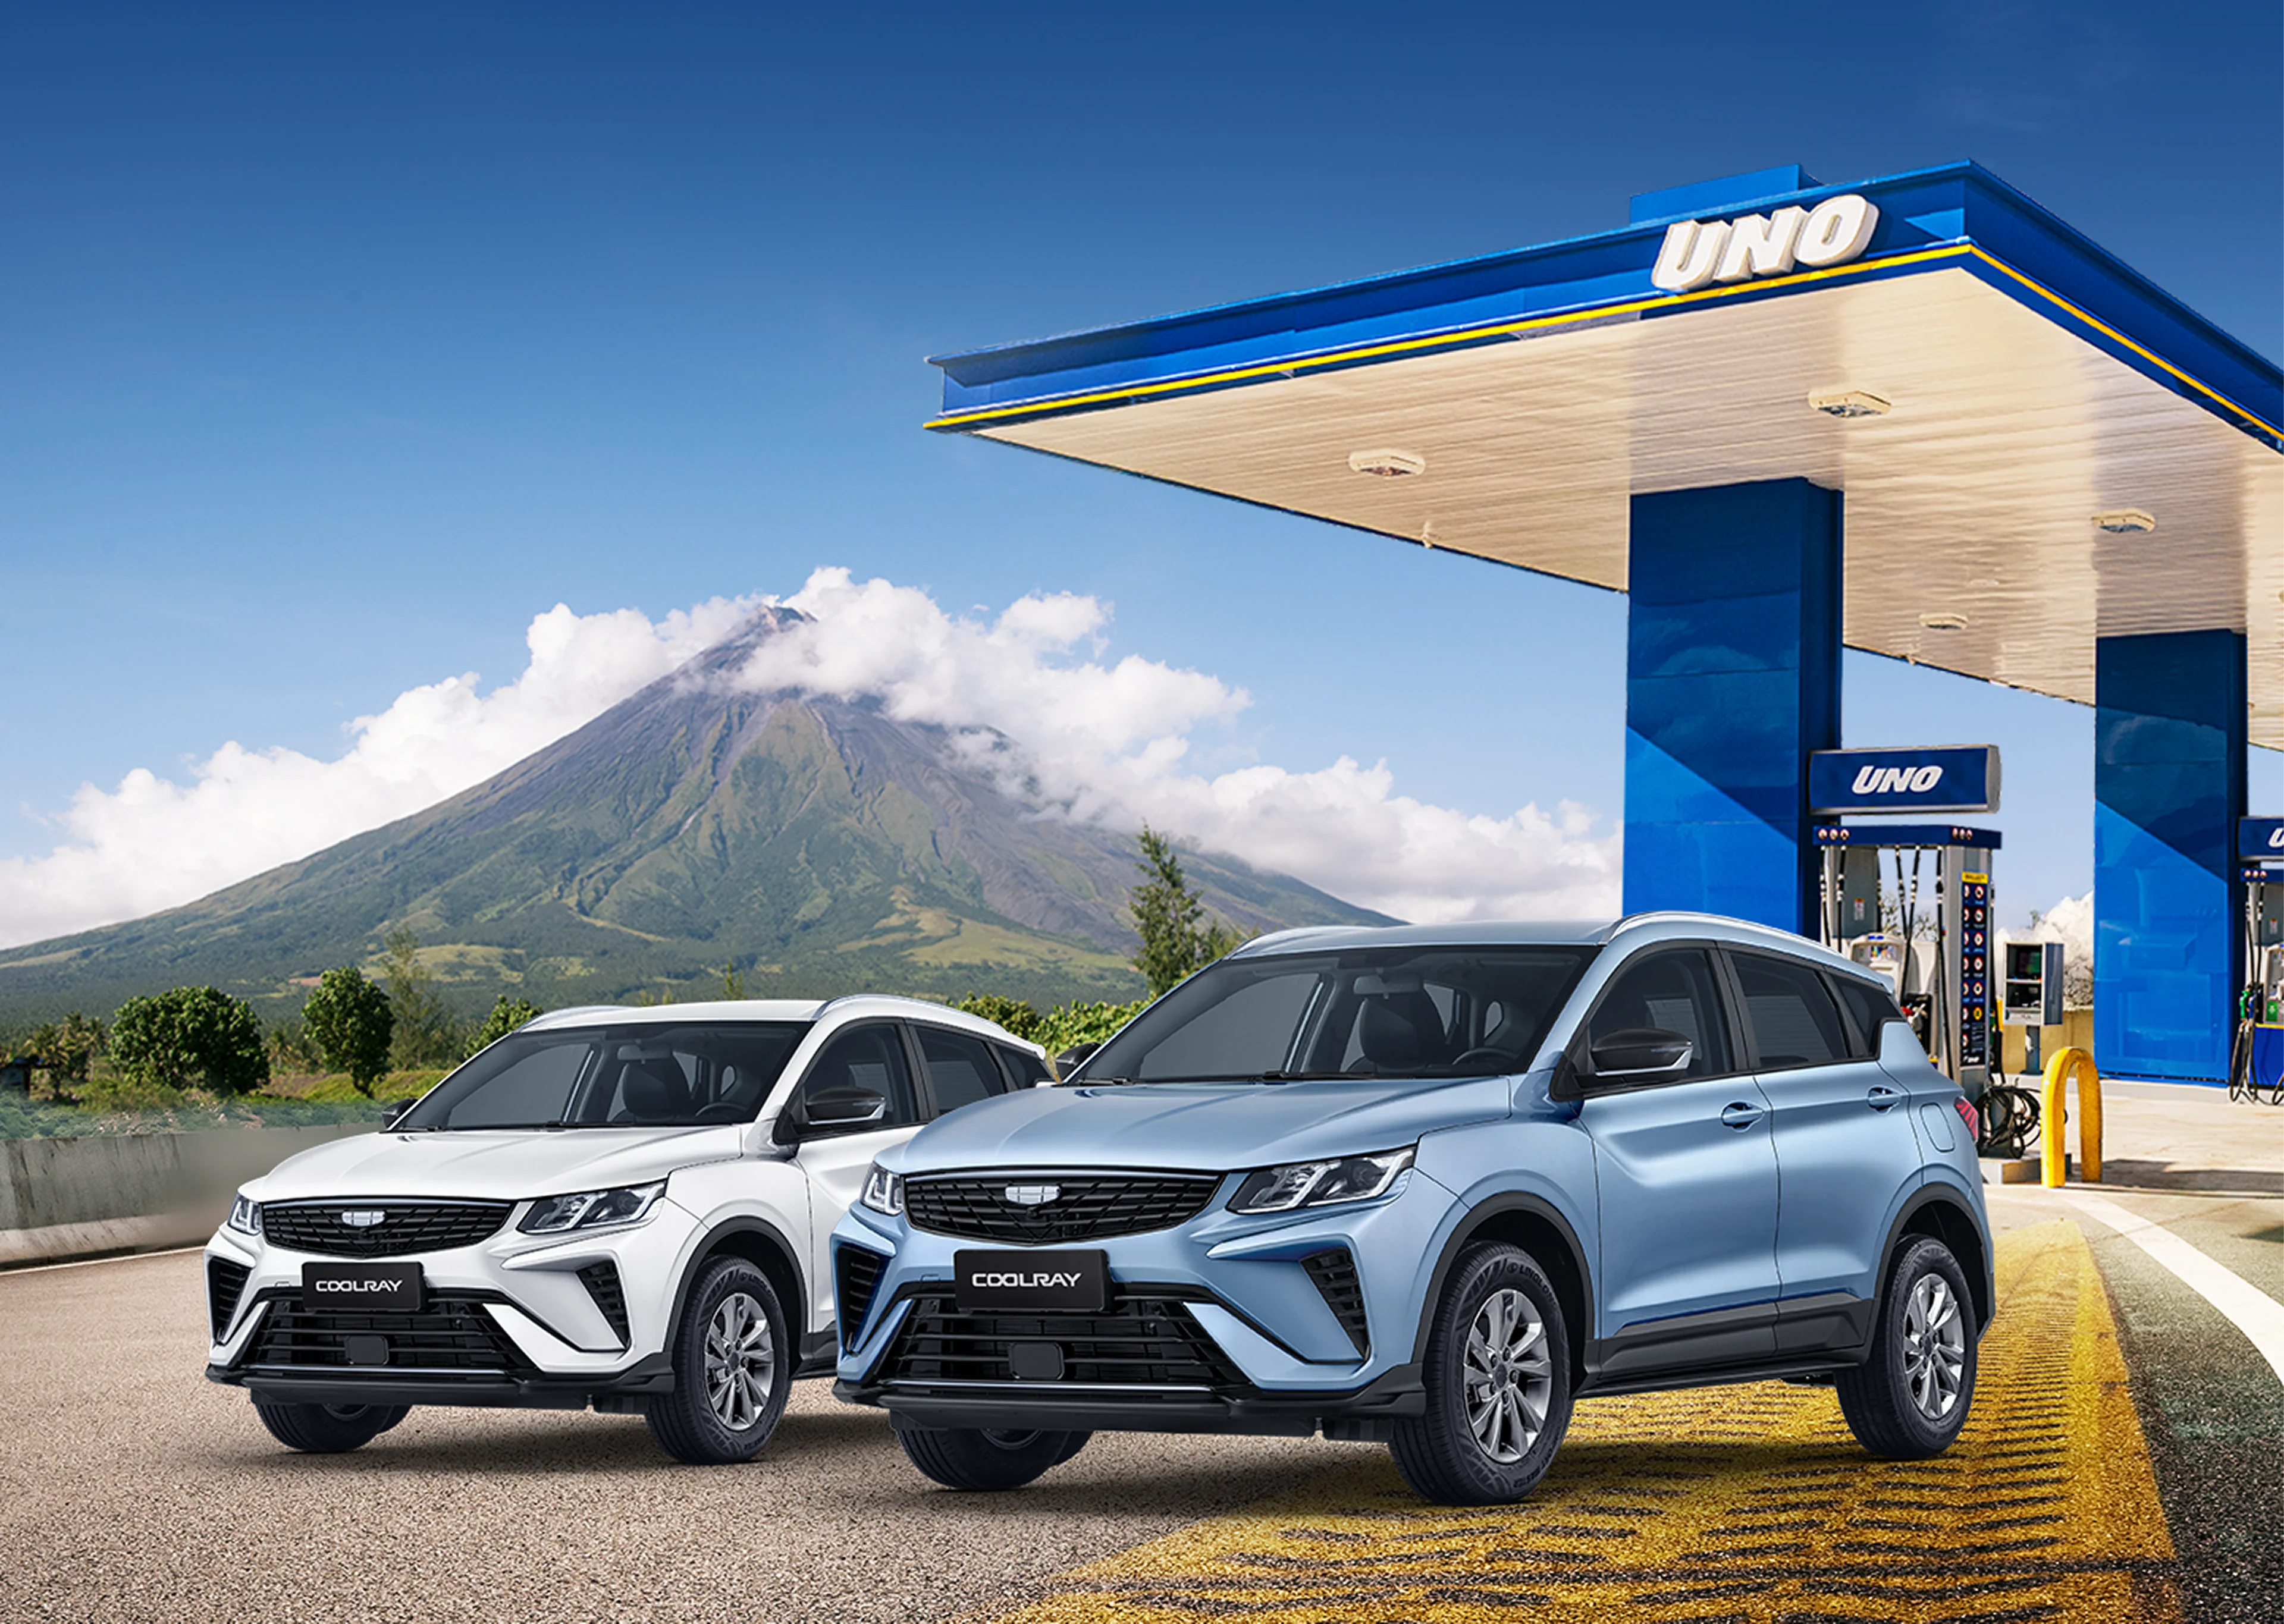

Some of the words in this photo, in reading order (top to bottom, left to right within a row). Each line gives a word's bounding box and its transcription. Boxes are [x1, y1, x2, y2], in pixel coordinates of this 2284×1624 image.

[1651, 194, 1880, 291] UNO
[1852, 765, 1943, 794] UNO
[315, 1280, 403, 1292] COOLRAY
[971, 1273, 1082, 1287] COOLRAY
